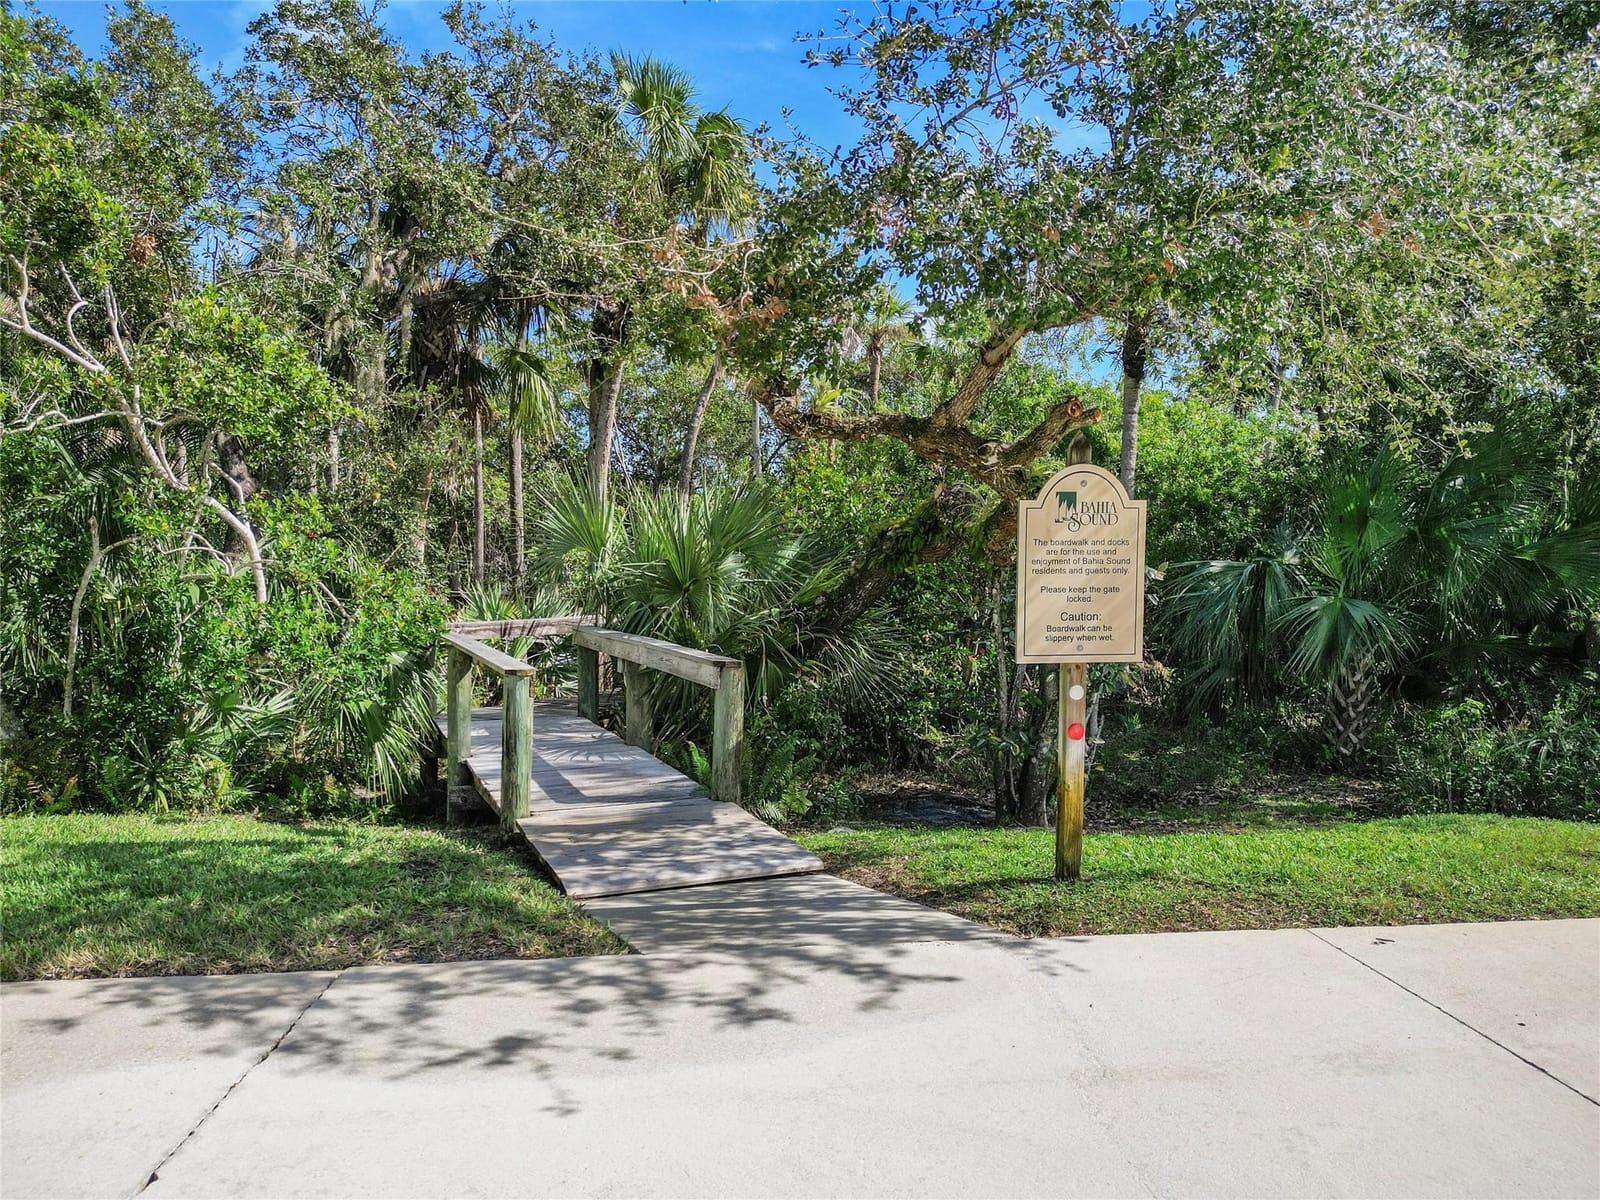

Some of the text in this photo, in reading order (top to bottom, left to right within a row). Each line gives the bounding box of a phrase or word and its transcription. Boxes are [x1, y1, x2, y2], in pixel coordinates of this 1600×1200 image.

[1081, 501, 1117, 513] BAHIA
[1068, 513, 1118, 532] SOUND
[1032, 558, 1070, 566] enjoyment
[1085, 568, 1110, 576] guests
[1068, 586, 1087, 594] keep
[1103, 586, 1120, 594] gate
[1060, 612, 1101, 621] Caution:
[1045, 635, 1073, 643] slippery
